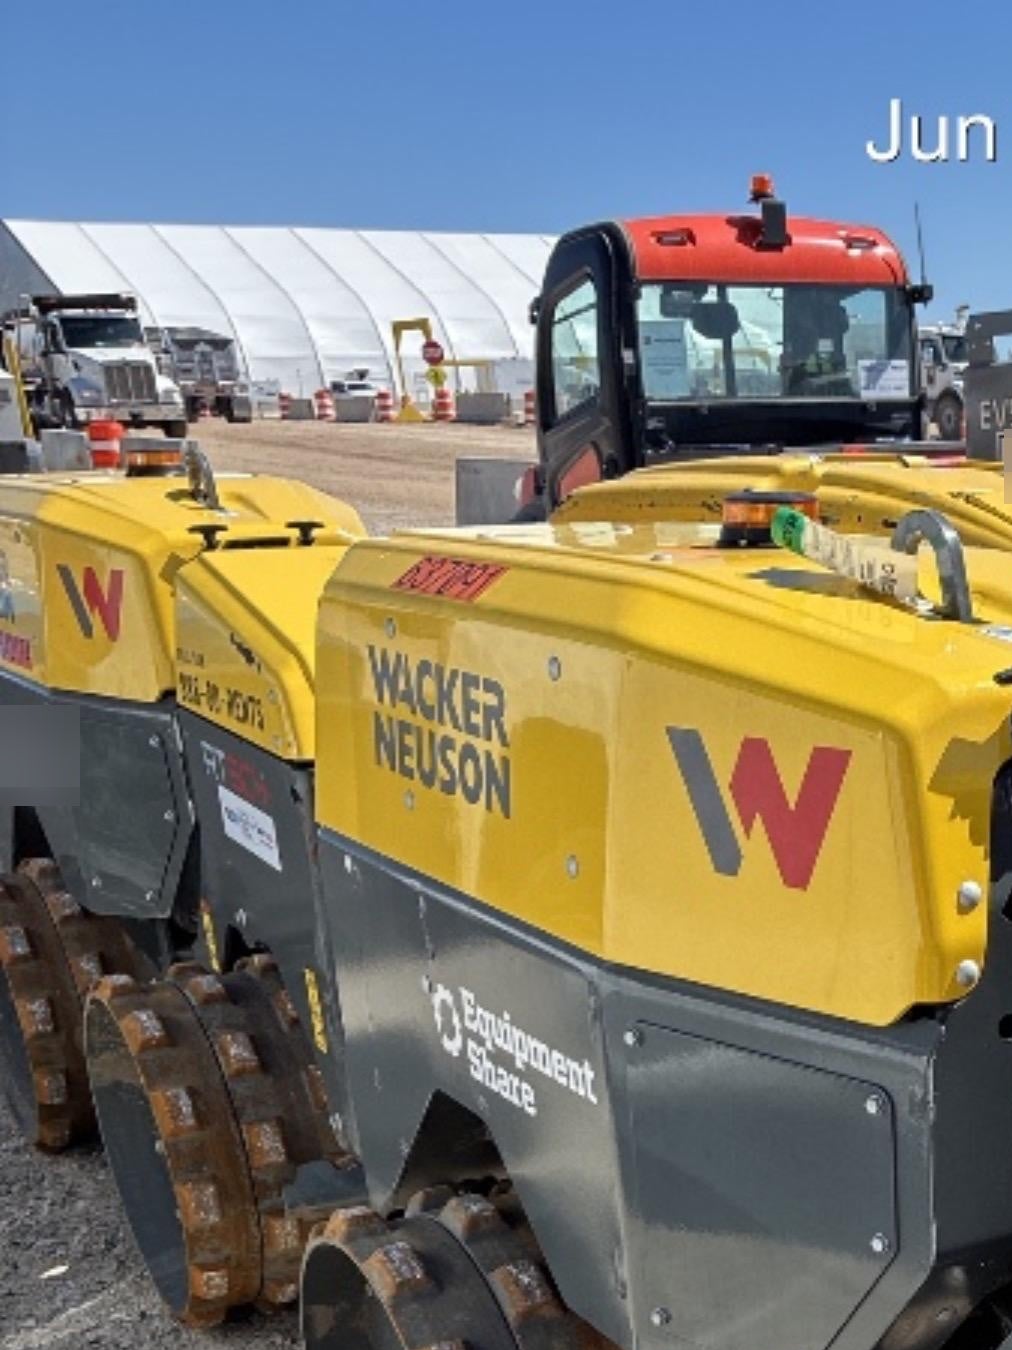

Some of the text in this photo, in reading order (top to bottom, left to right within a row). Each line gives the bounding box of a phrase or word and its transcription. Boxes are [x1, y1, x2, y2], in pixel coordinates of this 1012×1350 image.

[367, 644, 510, 748] WACKER
[373, 711, 511, 819] NEUSON
[457, 985, 598, 1105] Equipment
[466, 1042, 539, 1117] Share
